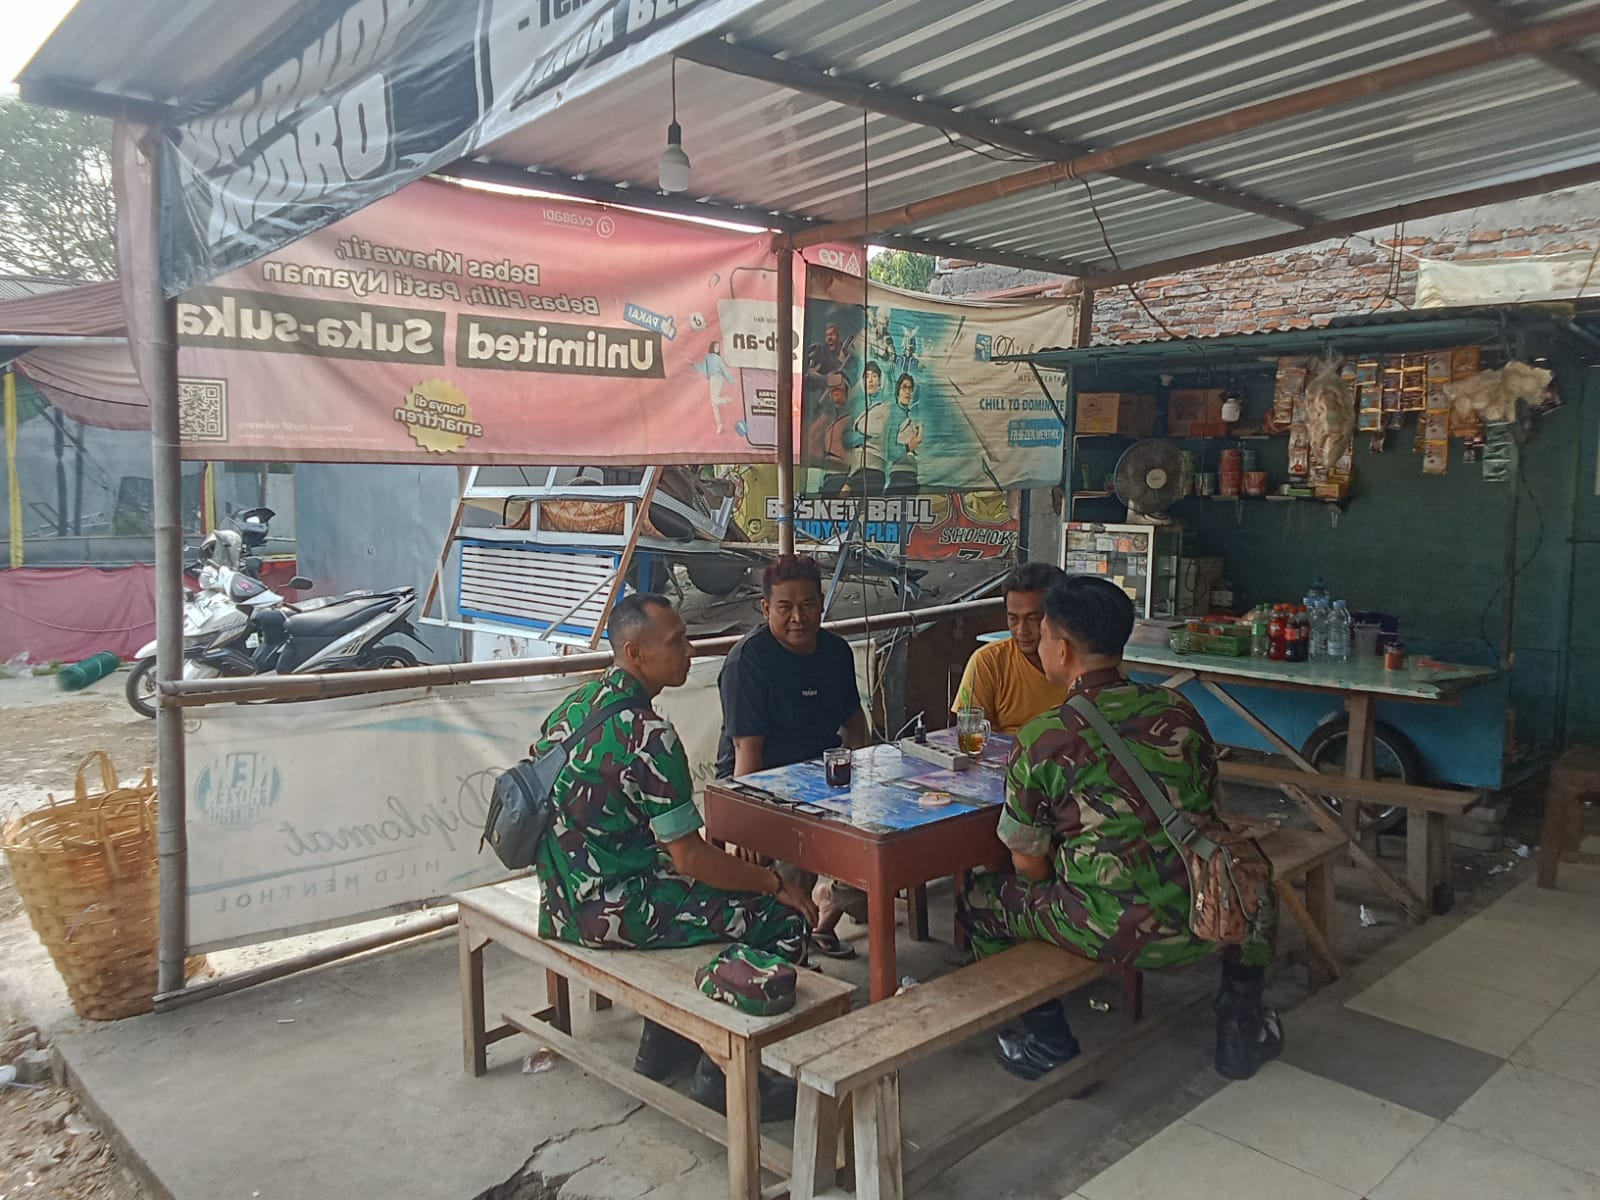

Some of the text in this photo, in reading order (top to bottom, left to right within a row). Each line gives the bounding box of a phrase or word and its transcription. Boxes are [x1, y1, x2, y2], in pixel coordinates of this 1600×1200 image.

[207, 73, 389, 246] INDRO
[979, 398, 1006, 412] CHILL
[1008, 399, 1020, 412] TO
